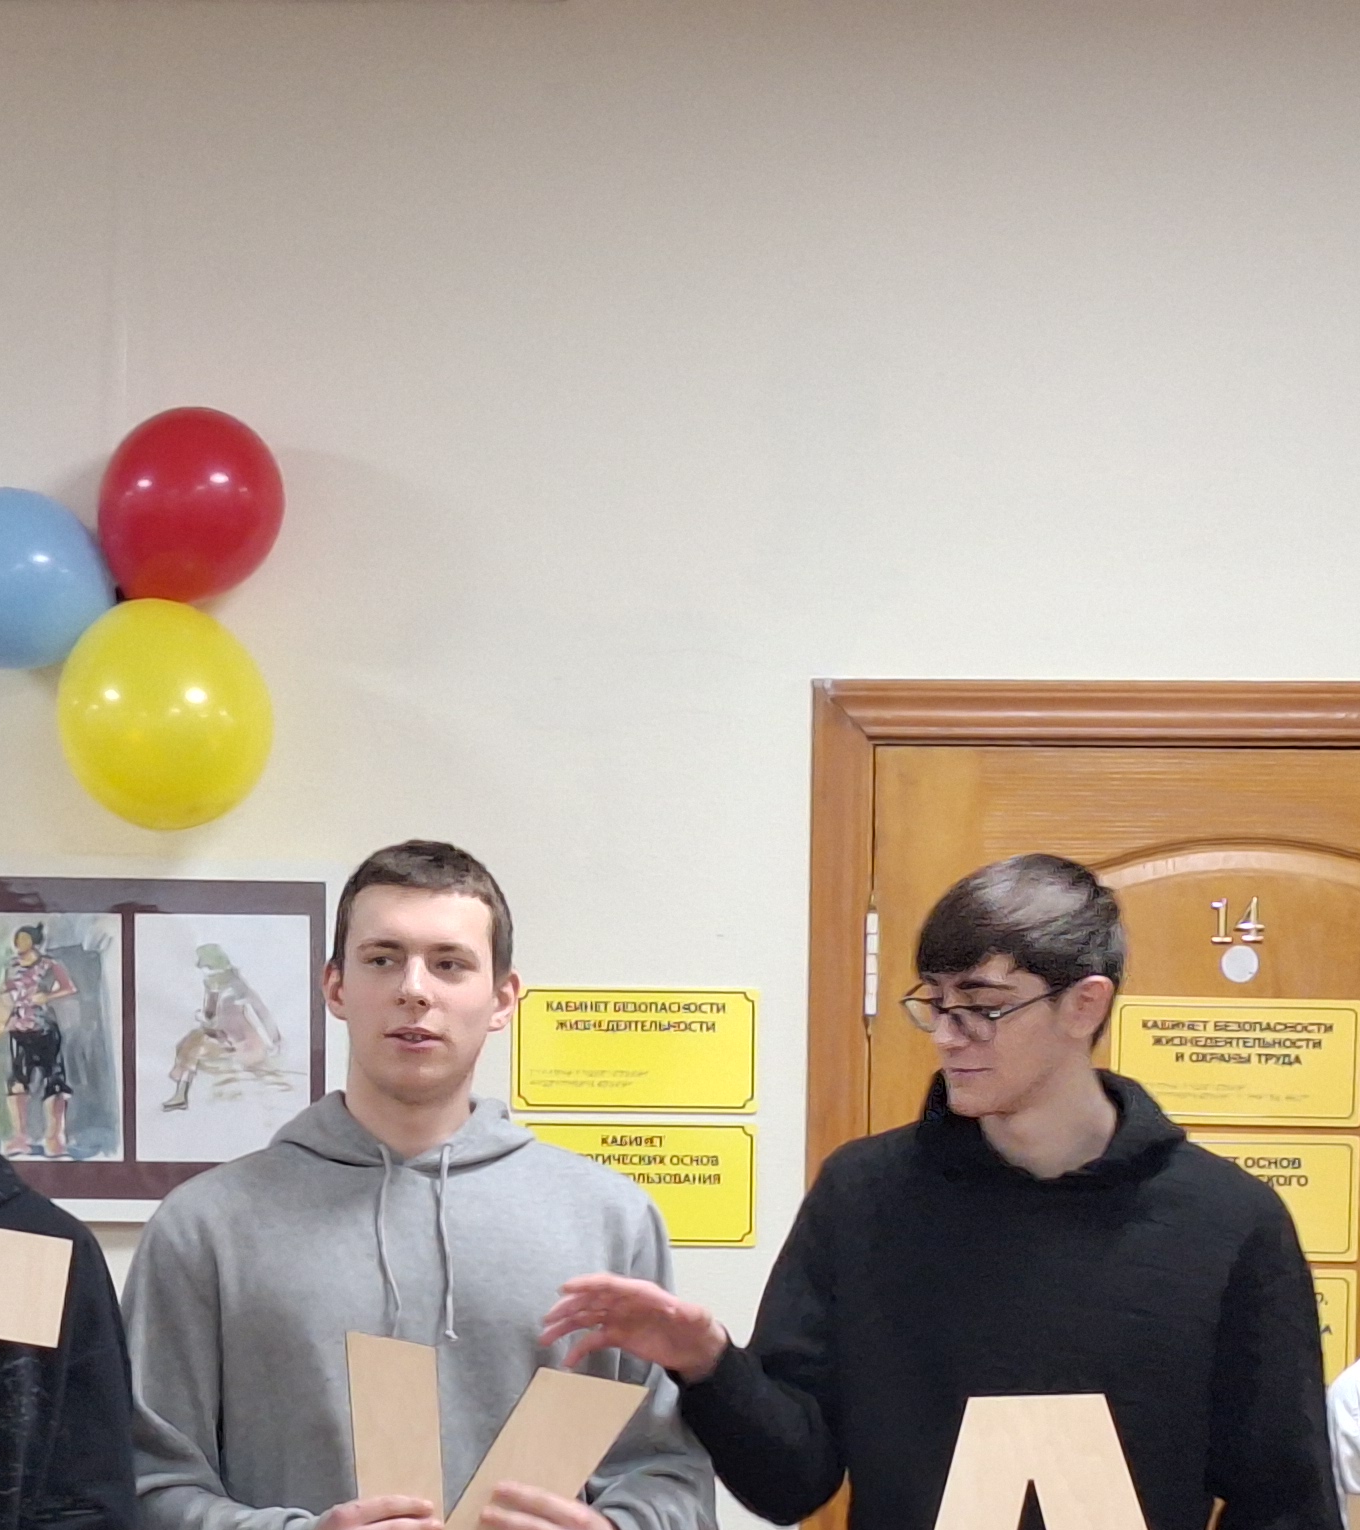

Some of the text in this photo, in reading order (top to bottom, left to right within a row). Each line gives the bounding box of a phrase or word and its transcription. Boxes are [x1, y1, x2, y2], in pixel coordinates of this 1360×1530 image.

[1210, 895, 1265, 944] 14
[546, 1001, 726, 1014] КАБИНЕТ БЕЗОПАСНОСТИ
[556, 1020, 716, 1033] ЖИЗНЕДЕЯТЕЛЬНОСТИ
[1142, 1019, 1334, 1033] КАБИНЕТ БЕЗОПАСНОСТИ
[1152, 1035, 1322, 1049] ЖИЗНЕДЕЯТЕЛЬНОСТИ
[1175, 1052, 1302, 1066] И ОХРАНЫ ТРУДА
[601, 1135, 664, 1148] КАБИНЕТ
[580, 1153, 719, 1167] ГИЧЕСКИХ ОСНОВ
[1244, 1157, 1302, 1169] ОСНОВ
